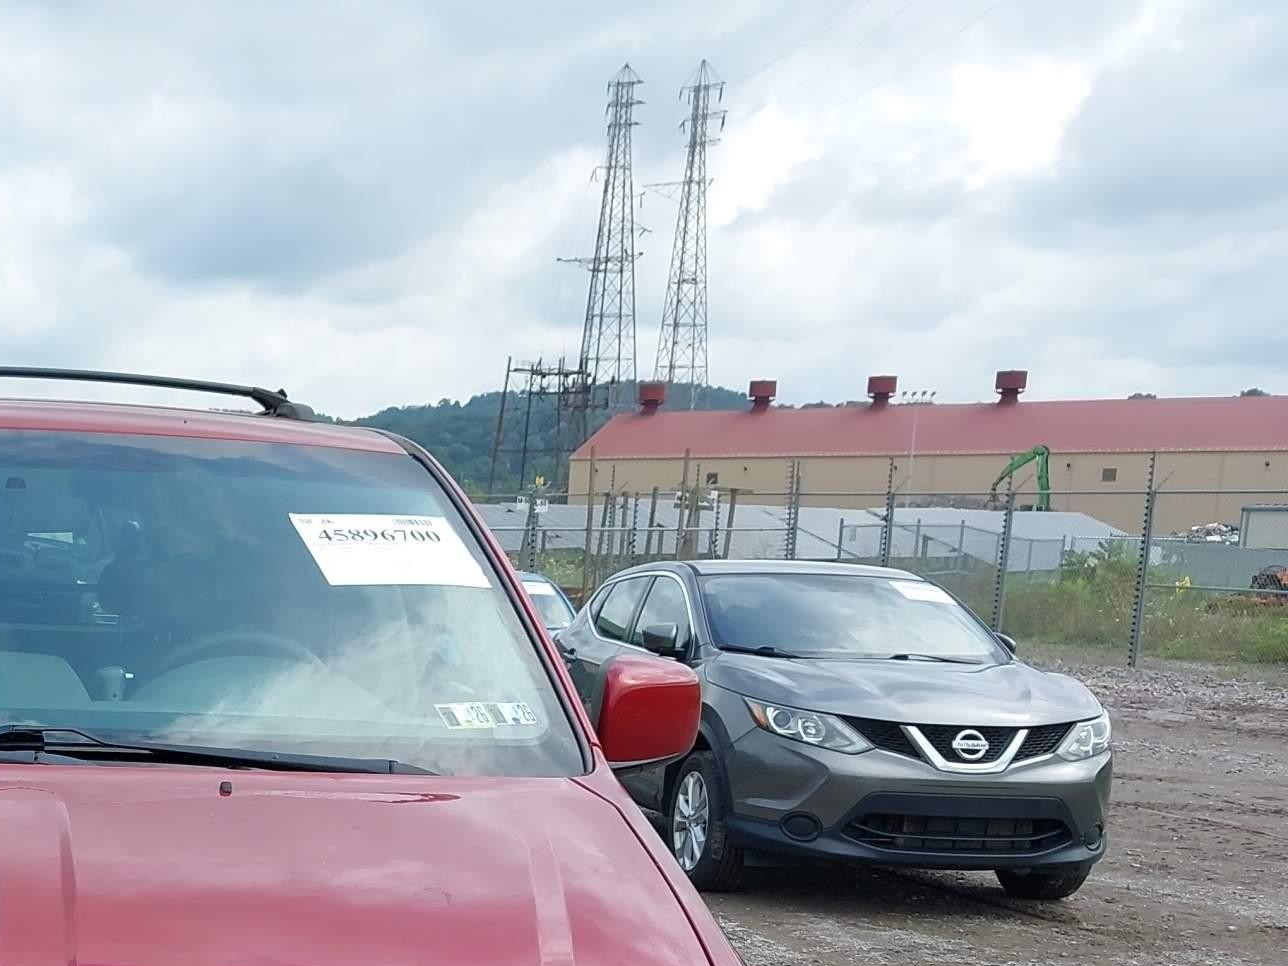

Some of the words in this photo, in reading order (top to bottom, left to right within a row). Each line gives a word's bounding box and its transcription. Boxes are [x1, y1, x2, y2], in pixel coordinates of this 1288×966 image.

[318, 528, 441, 542] 45896700
[470, 705, 490, 724] 26
[516, 704, 537, 722] 26
